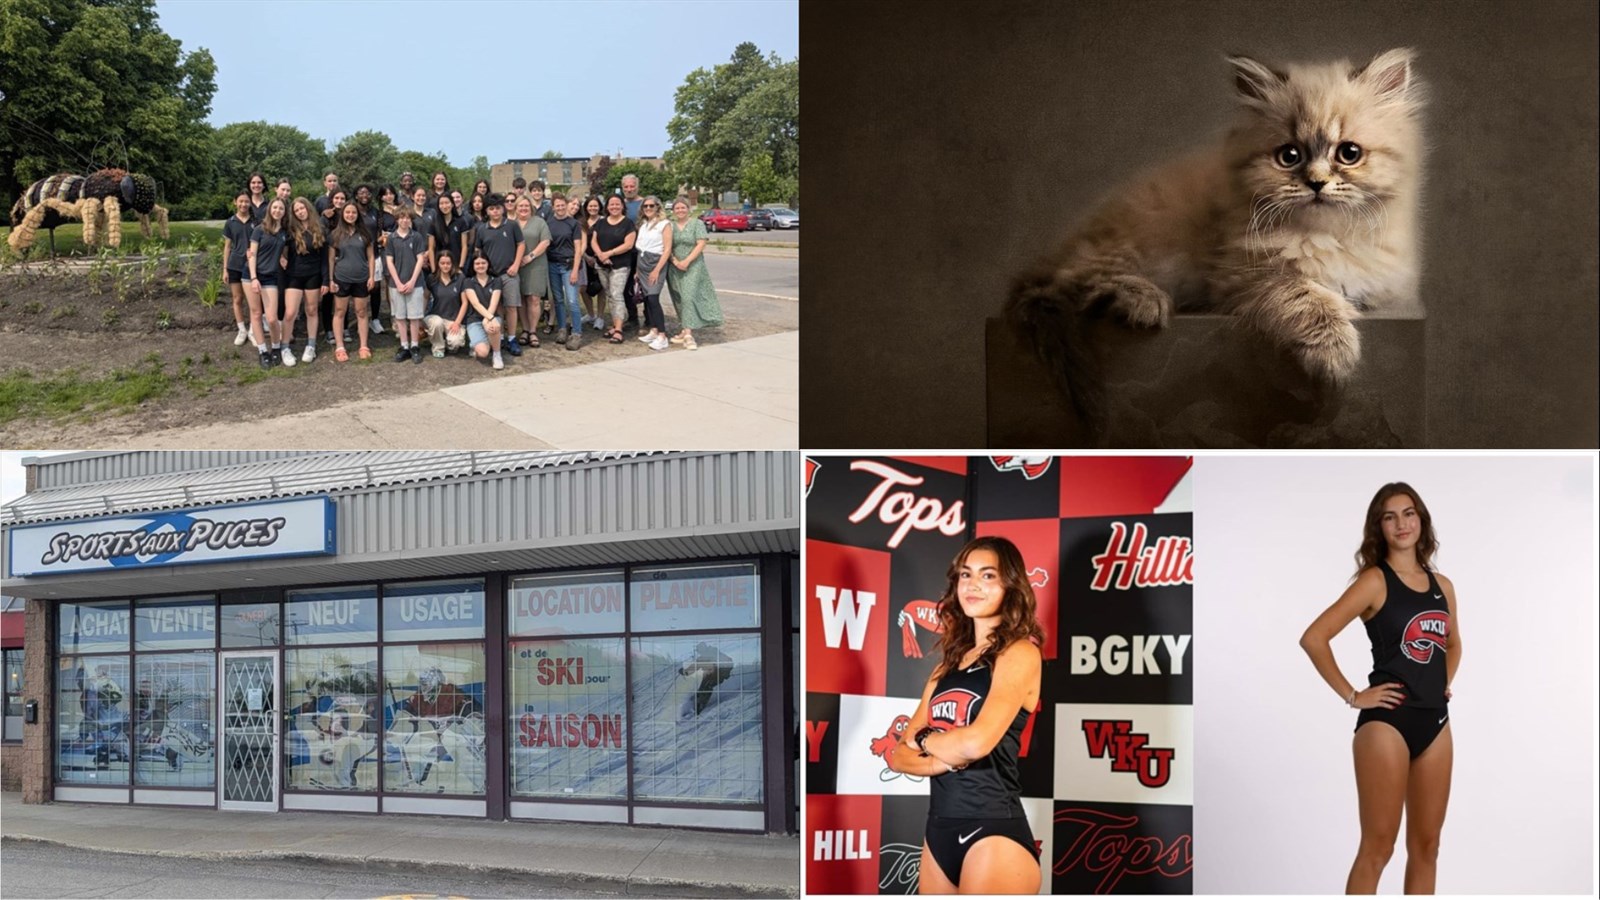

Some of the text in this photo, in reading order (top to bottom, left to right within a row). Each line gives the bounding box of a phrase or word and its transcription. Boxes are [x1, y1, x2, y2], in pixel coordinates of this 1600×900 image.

[849, 460, 965, 549] Tops
[41, 531, 147, 565] SPORTS
[186, 517, 286, 550] PUCES
[69, 589, 473, 637] ACHAT VENTE NEUF USAGÉ
[515, 578, 748, 617] LOCATION PLANCHE
[916, 606, 942, 625] WK
[815, 584, 877, 651] W
[1419, 619, 1446, 635] WKU
[537, 657, 584, 686] SKI
[1071, 634, 1192, 676] BGKY
[519, 713, 622, 748] SAISON
[931, 701, 957, 721] WKU
[1081, 719, 1175, 788] WKU
[813, 829, 872, 861] HILL
